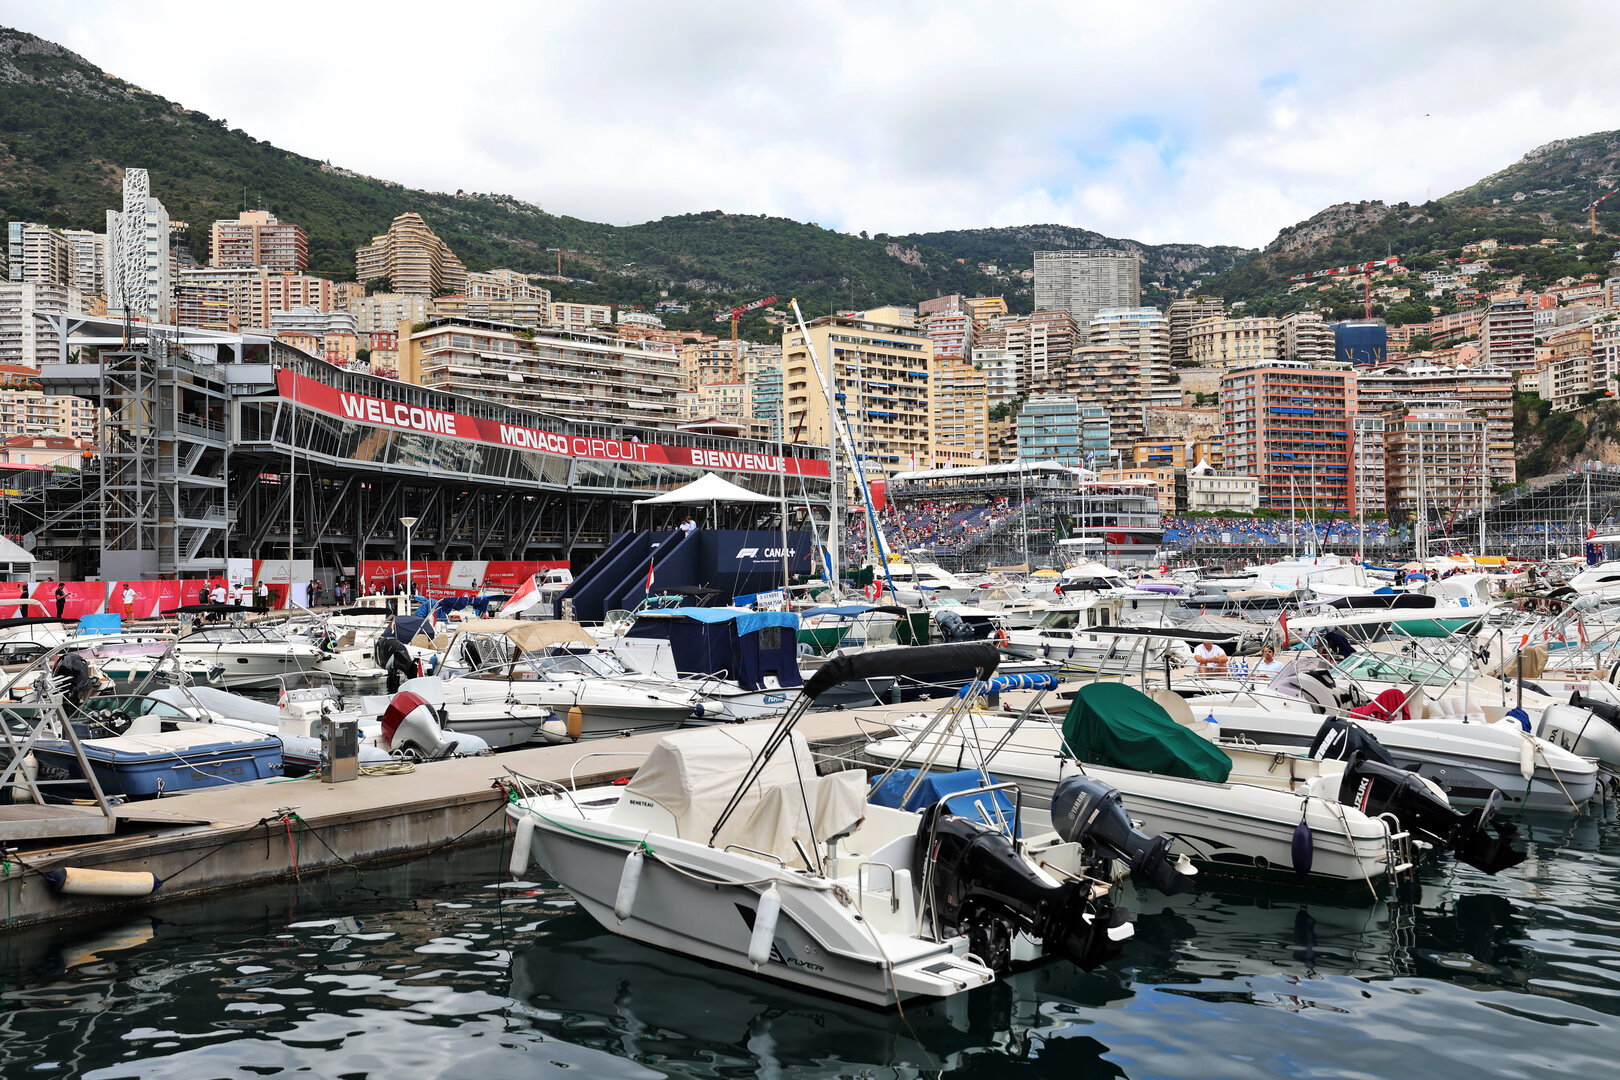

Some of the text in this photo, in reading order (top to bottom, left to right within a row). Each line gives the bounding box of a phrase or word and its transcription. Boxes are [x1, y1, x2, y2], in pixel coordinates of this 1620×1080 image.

[340, 393, 457, 435] WELCOME
[500, 424, 649, 460] MONACO CIRCUIT
[691, 449, 786, 472] BIENVENUE
[629, 799, 654, 808] BENETEAU
[1071, 790, 1088, 814] YAMAHA
[1353, 777, 1370, 810] UZUKI
[786, 957, 825, 973] FLYER
